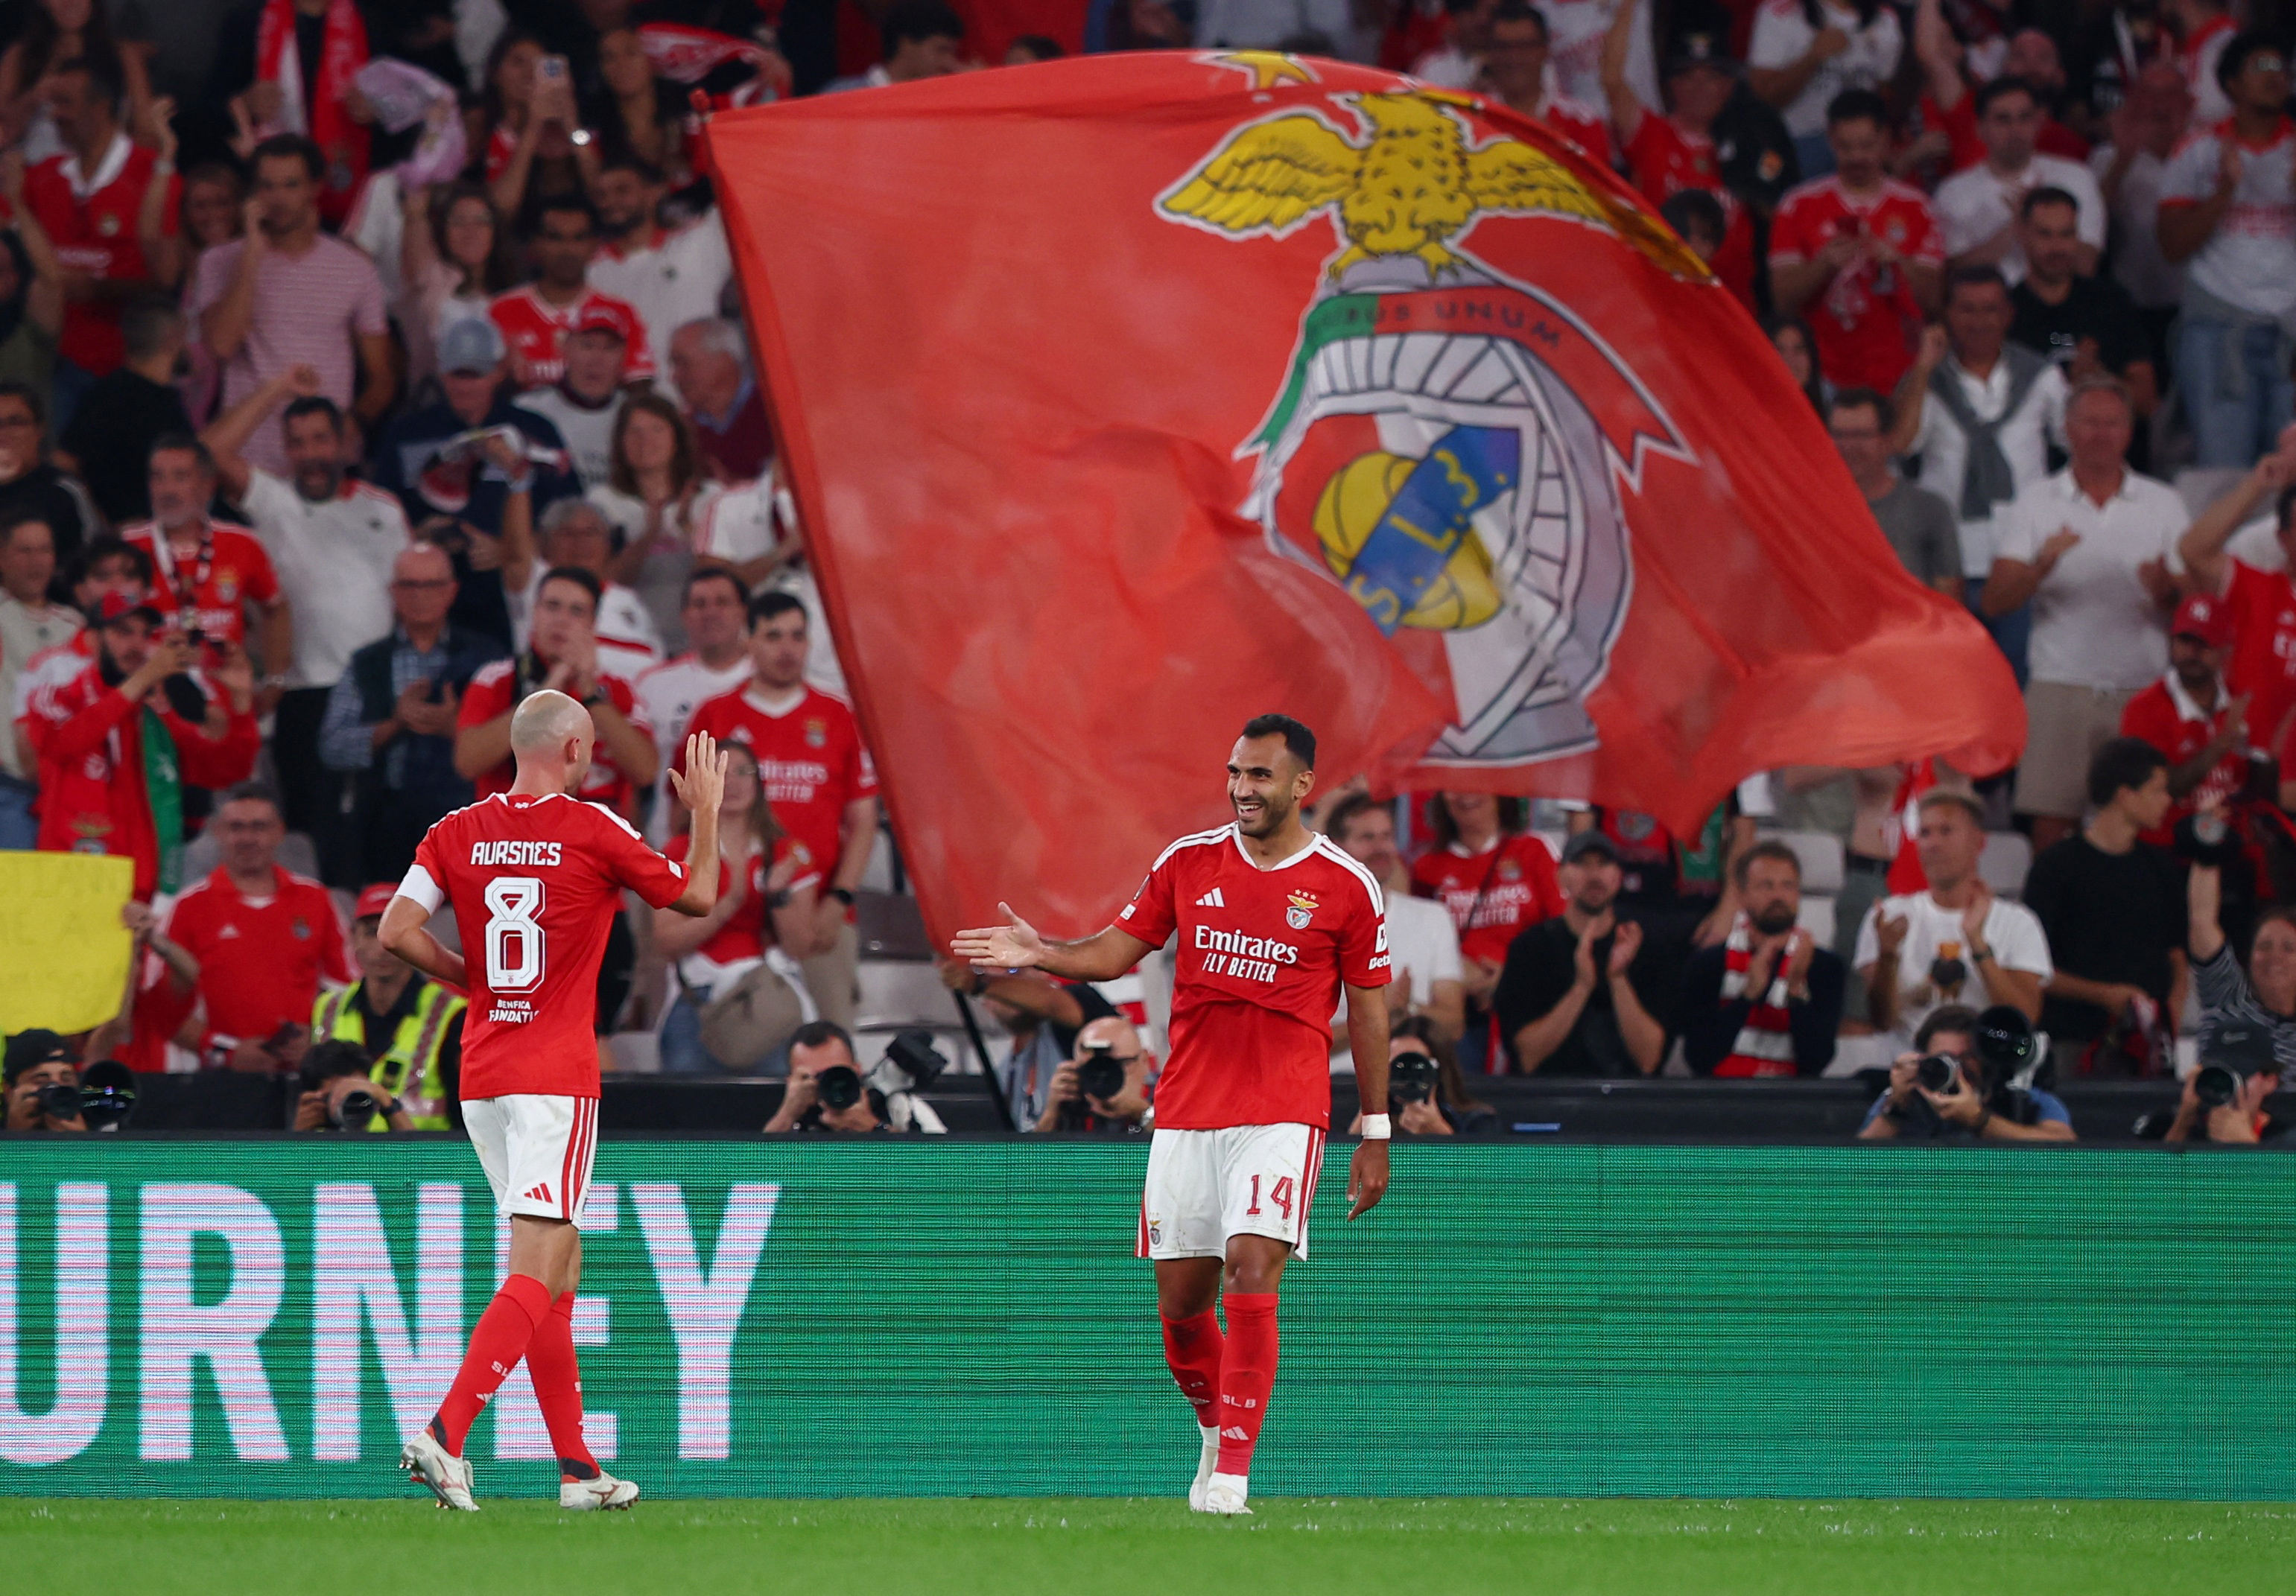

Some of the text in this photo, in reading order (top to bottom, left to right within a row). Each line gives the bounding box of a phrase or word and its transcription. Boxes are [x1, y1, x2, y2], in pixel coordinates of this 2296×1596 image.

[1434, 299, 1561, 349] UNUM
[471, 841, 562, 866] AURSNES
[485, 877, 545, 993] 8
[1195, 925, 1298, 964] Emirates
[1202, 952, 1277, 983] FLY BETTER
[1246, 1174, 1294, 1221] 14
[1222, 1393, 1257, 1408] SLB
